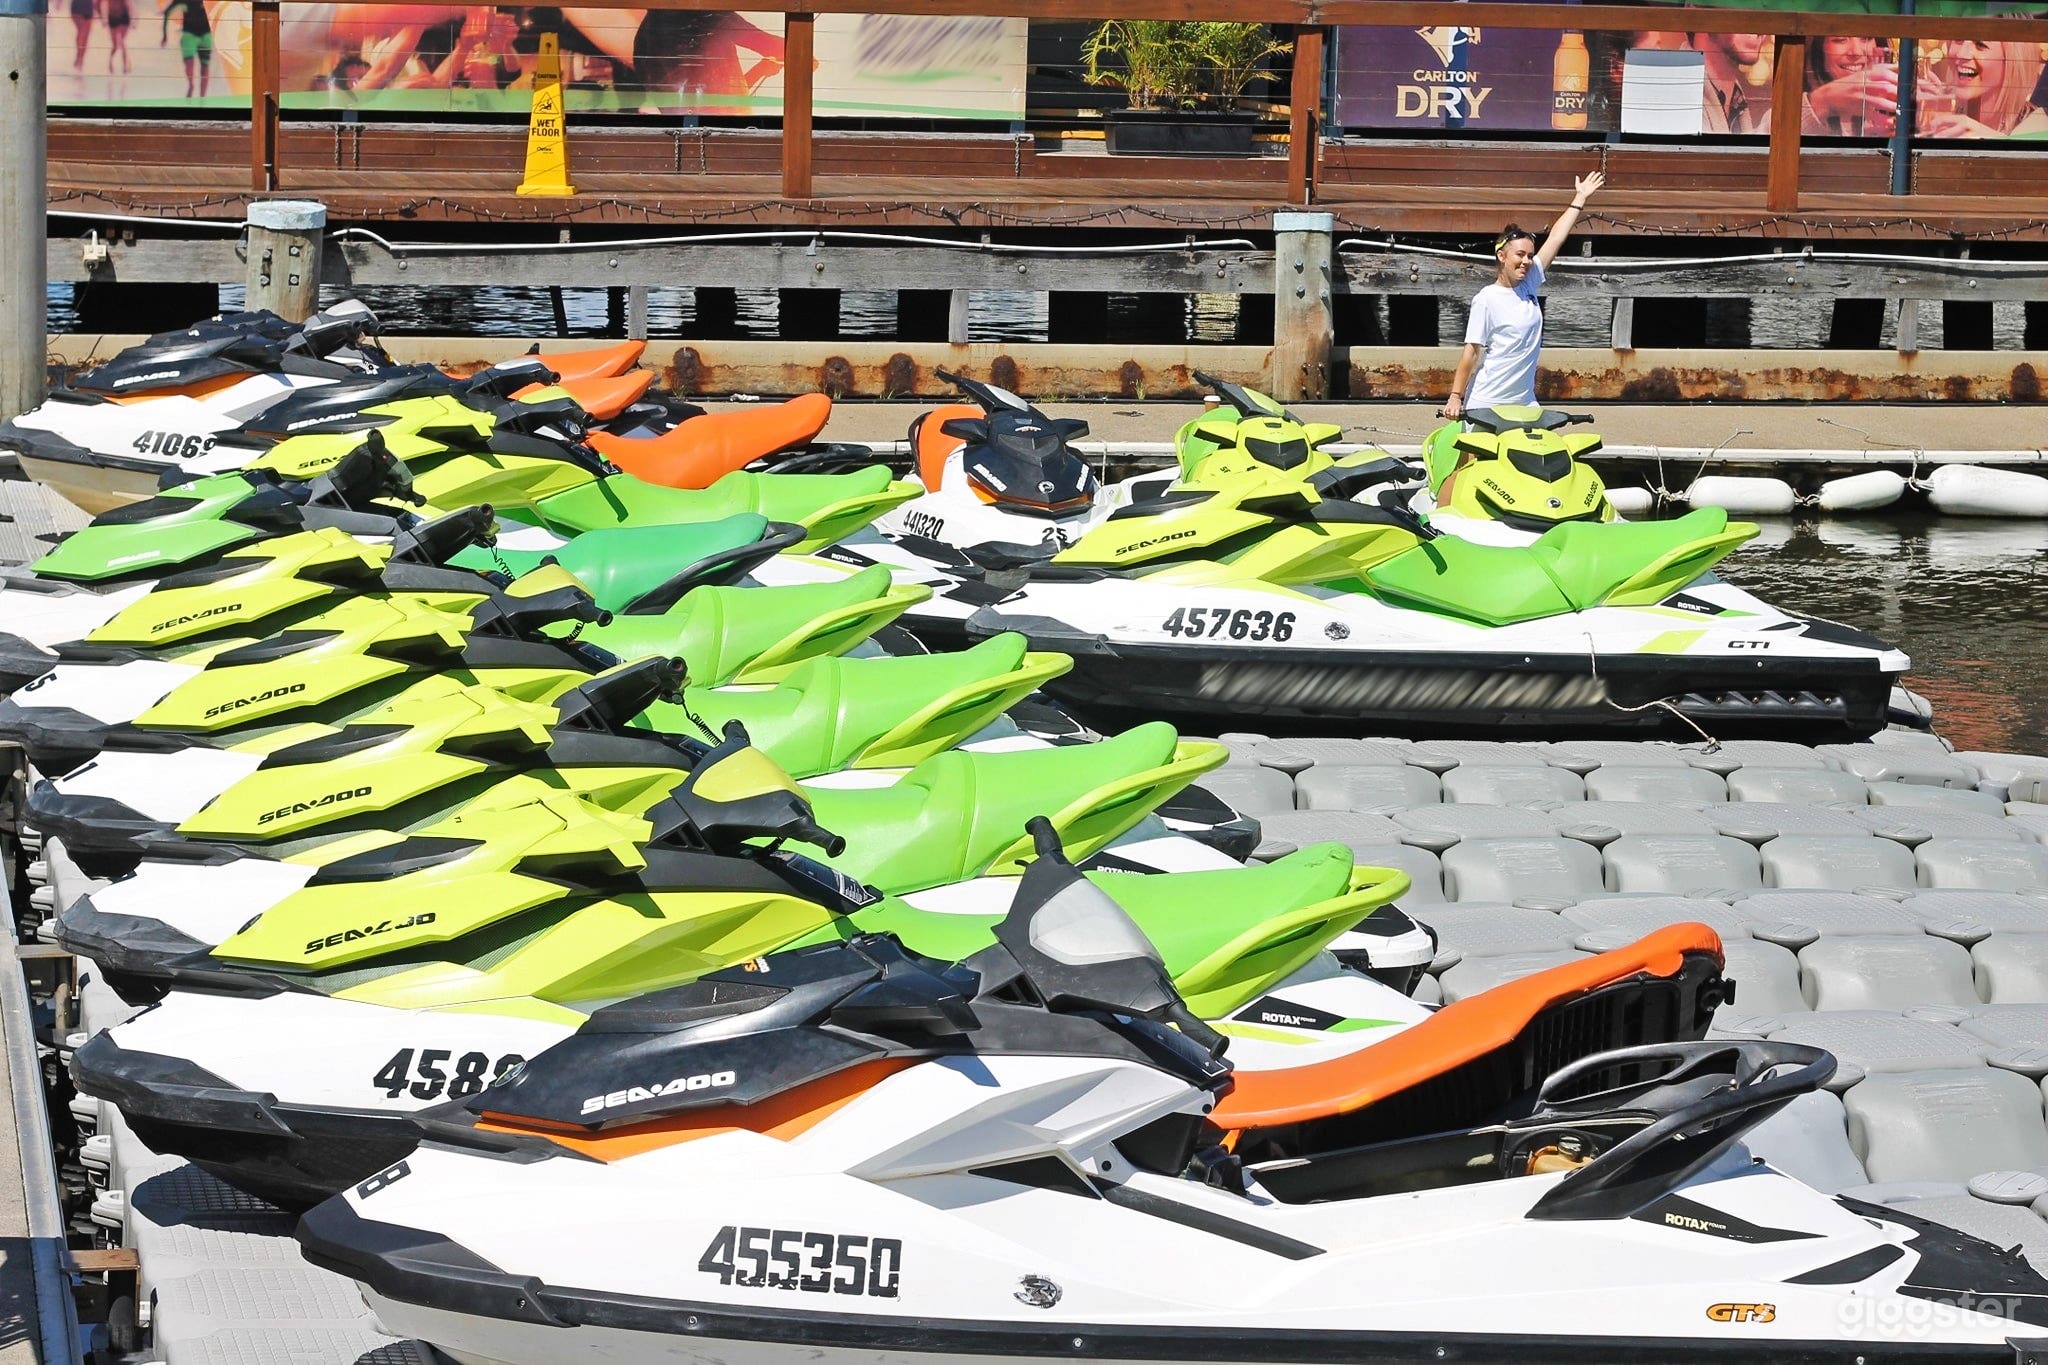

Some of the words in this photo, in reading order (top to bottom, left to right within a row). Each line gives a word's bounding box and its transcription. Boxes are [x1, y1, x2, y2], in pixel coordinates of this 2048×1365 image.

[1413, 69, 1477, 82] CARLTON
[1396, 85, 1493, 119] DRY
[1555, 97, 1585, 109] DRY
[537, 119, 555, 127] WET
[532, 127, 560, 137] FLOOR
[1162, 607, 1296, 642] 457636
[1727, 640, 1771, 650] GTI
[1261, 1012, 1301, 1025] ROTAX
[1665, 1213, 1709, 1231] ROTAX
[698, 1225, 902, 1298] 455350
[1706, 1302, 1776, 1323] GTS
